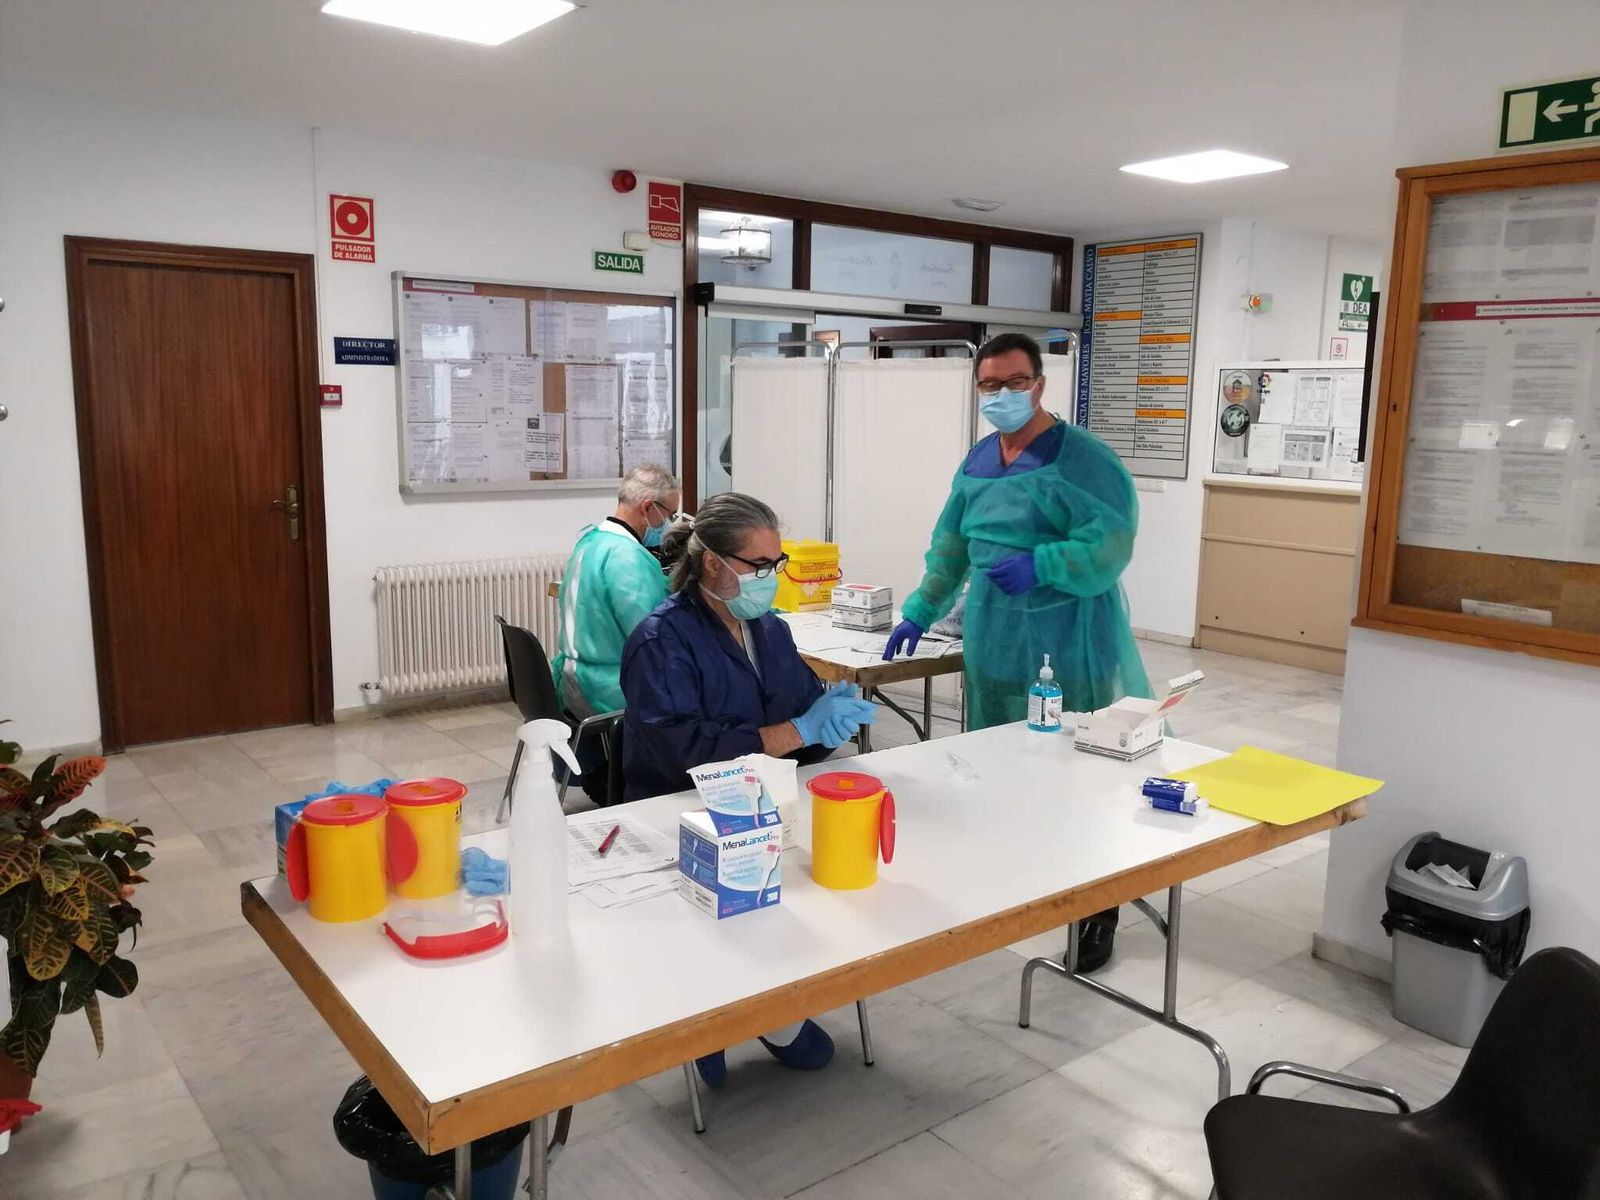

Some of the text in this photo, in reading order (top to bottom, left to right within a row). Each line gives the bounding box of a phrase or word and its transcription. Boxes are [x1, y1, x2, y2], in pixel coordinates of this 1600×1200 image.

[650, 224, 680, 233] AVISADOR
[651, 230, 678, 239] SONORO
[335, 243, 371, 253] PULSADOR
[345, 251, 373, 260] ALARMA
[598, 254, 641, 271] SALIDA
[1352, 302, 1368, 314] DEA
[342, 340, 386, 349] DIRECTOR
[1081, 343, 1090, 387] MAYORES
[722, 832, 770, 851] MenaLancet
